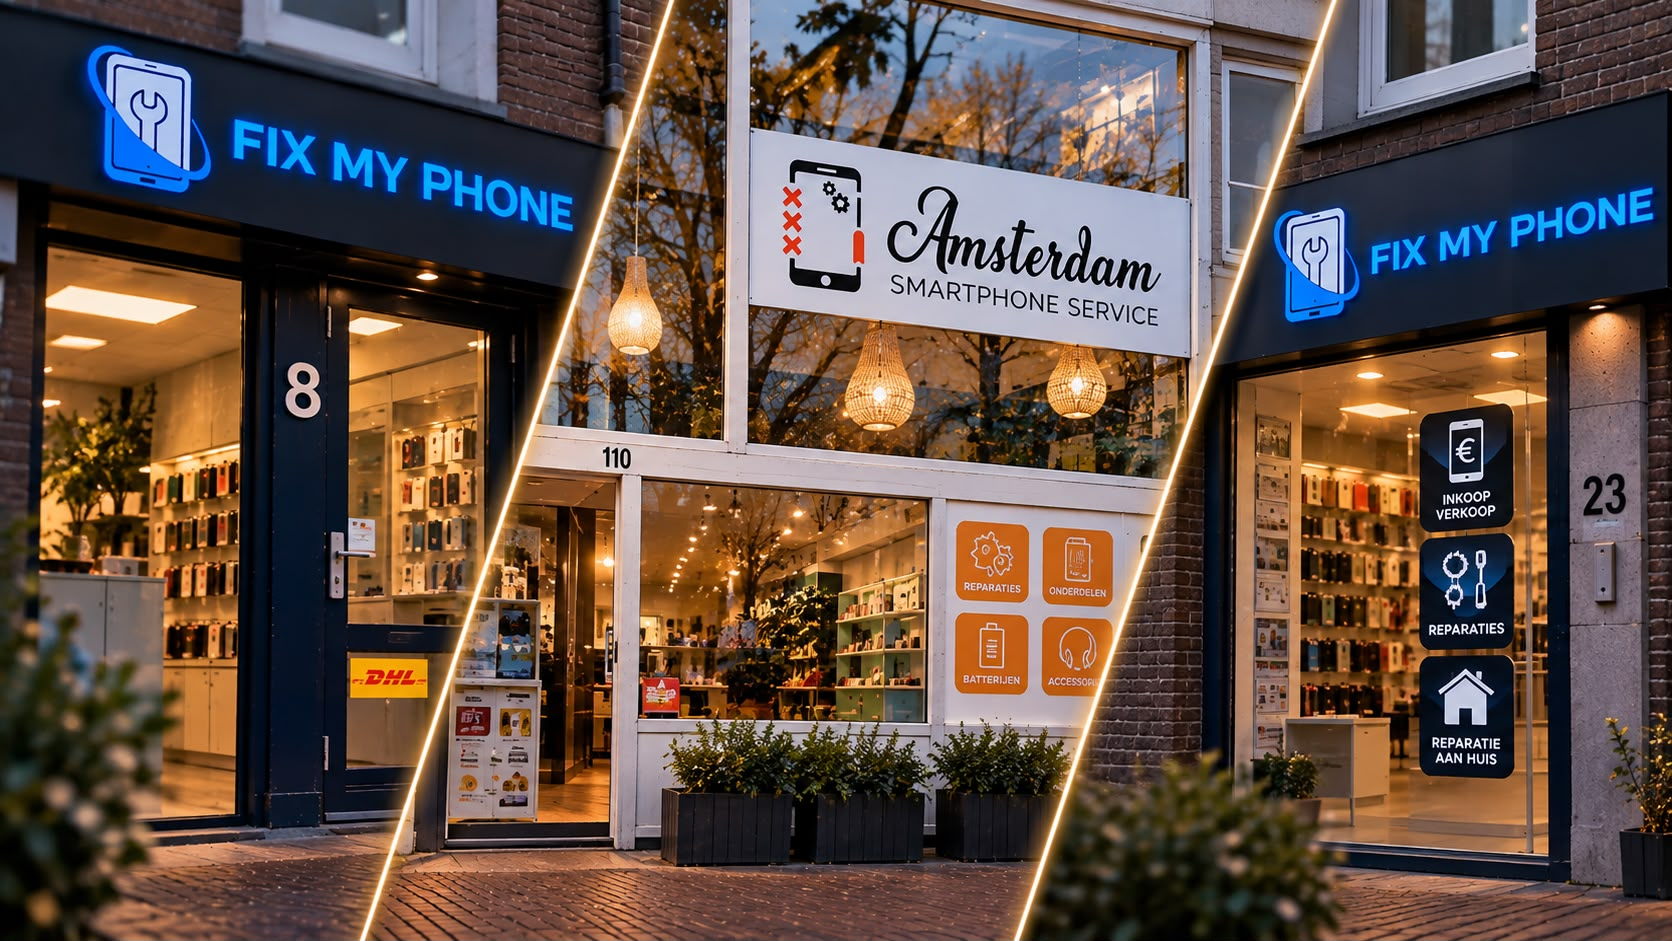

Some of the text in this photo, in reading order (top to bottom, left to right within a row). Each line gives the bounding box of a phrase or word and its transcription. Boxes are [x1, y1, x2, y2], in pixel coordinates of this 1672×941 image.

[233, 119, 574, 232] FIX MY PHONE
[887, 185, 1162, 293] Amsterdam
[1371, 187, 1654, 275] FIX MY PHONE
[890, 274, 1159, 327] SMARTPHONE SERVICE
[285, 361, 322, 419] 8
[602, 446, 632, 470] 110
[1442, 490, 1492, 506] INKOOP
[1583, 473, 1627, 516] 23
[1435, 504, 1497, 521] VERKOOP
[963, 581, 1022, 594] REPARATIES
[1049, 586, 1106, 598] ONDERDELEN
[1428, 622, 1506, 637] REPARATIES
[364, 669, 418, 686] DHL
[963, 674, 1021, 686] BATTERIJEN
[1431, 736, 1501, 750] REPARATIE
[1435, 751, 1498, 766] AAN HUIS
